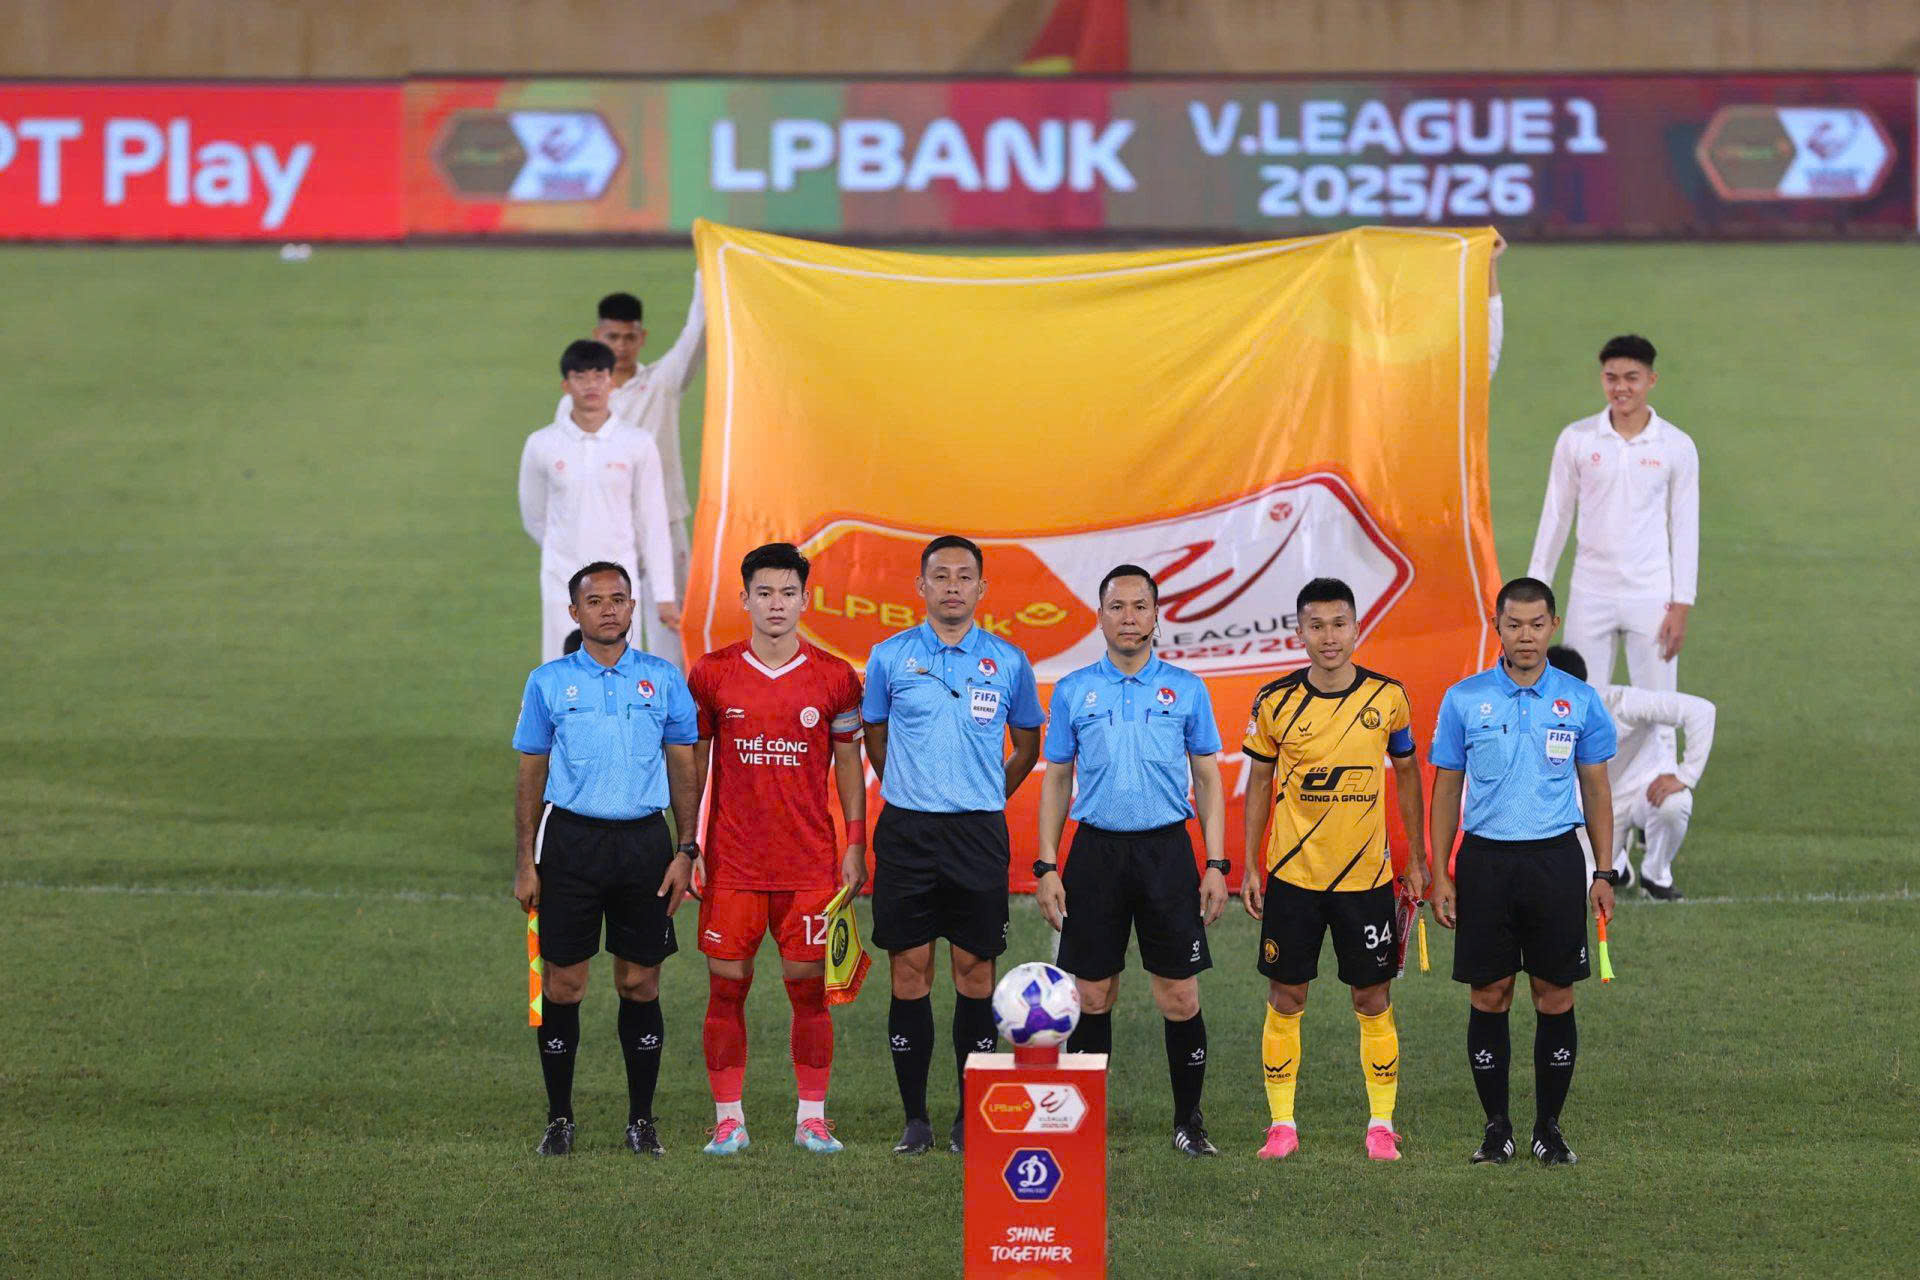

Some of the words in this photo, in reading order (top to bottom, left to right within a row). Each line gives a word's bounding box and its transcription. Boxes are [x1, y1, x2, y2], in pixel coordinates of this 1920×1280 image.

[1188, 99, 1555, 155] V.LEAGUE
[1568, 100, 1607, 154] 1
[711, 118, 1137, 193] LPBANK
[0, 118, 83, 205] T
[104, 118, 314, 230] Play
[1258, 165, 1535, 220] 2025/26
[813, 584, 1012, 637] LPBk
[1157, 635, 1306, 660] 025/26
[974, 691, 997, 703] FIFA
[734, 733, 765, 751] THỂ
[766, 737, 808, 753] CÔNG
[1549, 731, 1572, 743] FIFA
[739, 752, 801, 766] VIETTEL
[1300, 794, 1331, 802] DONG
[1341, 794, 1377, 802] GROUP
[803, 914, 829, 945] 12
[1364, 921, 1392, 949] 34
[1006, 1226, 1056, 1243] SHINE
[990, 1245, 1072, 1263] TOGETHER
